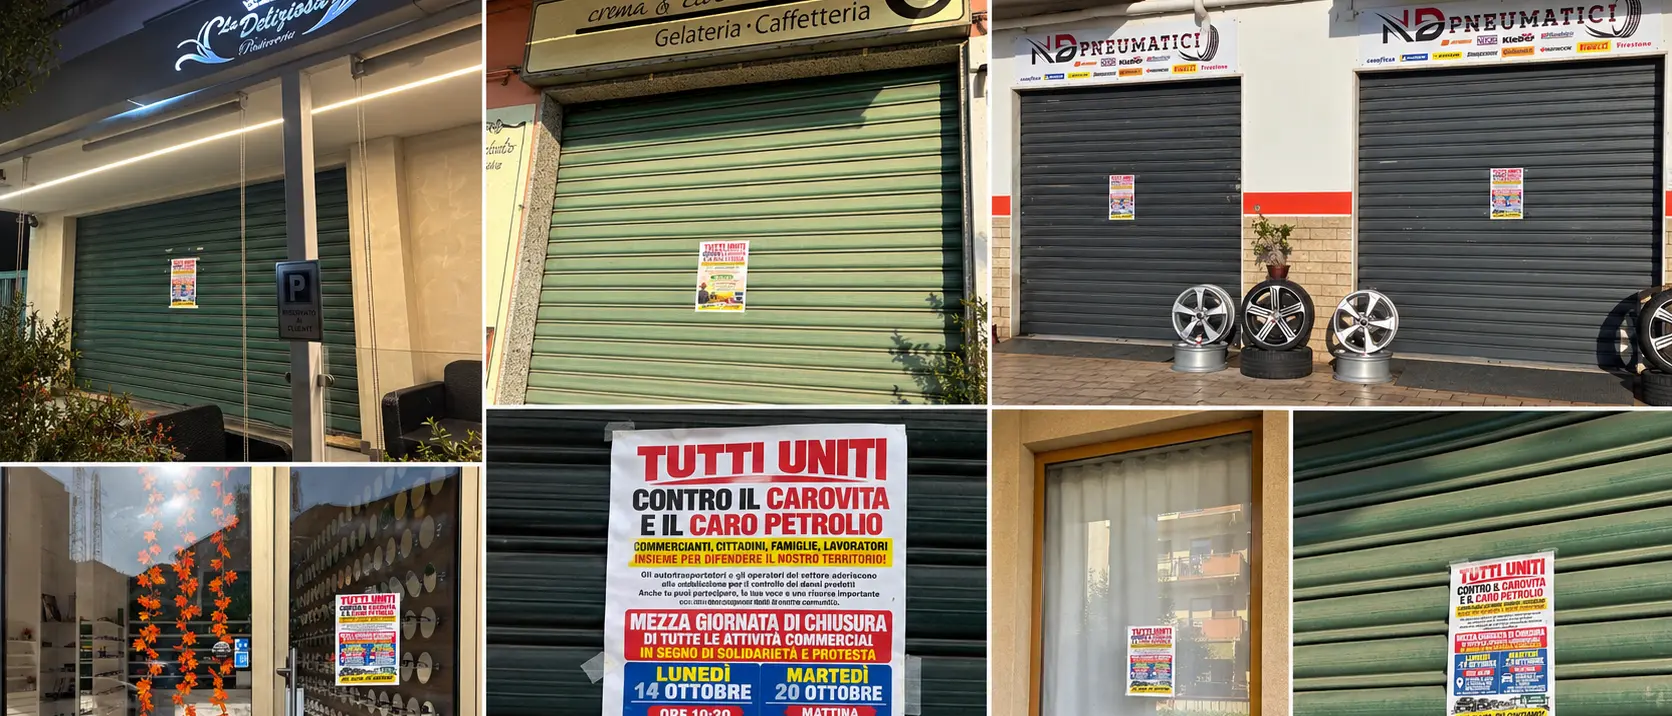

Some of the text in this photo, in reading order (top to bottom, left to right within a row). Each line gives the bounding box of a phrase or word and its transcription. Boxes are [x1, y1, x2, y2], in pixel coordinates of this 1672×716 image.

[588, 2, 648, 22] crema
[655, 0, 669, 15] &
[1449, 3, 1617, 33] PNEUMATICI
[655, 2, 870, 47] Gelateria Caffetteria
[1080, 32, 1200, 57] PNEUMATICI
[289, 275, 306, 301] P
[637, 438, 887, 481] TUTTI UNITI
[632, 487, 890, 511] CONTRO IL CAROVITA
[641, 513, 883, 536] E IL CARO PETROLIO
[634, 541, 888, 552] COMMERCIANTI, CITTADINI, FAMIGLIE, LAVORATORI
[634, 554, 887, 564] INSIEME PER DIFENDERE IL NOSTRO TERRITORIO!
[1459, 558, 1545, 584] TUTTI UNITI
[639, 589, 662, 597] Anche
[1457, 583, 1491, 595] CONTRO
[1501, 588, 1544, 600] PETROLIO
[340, 596, 369, 605] TUTTI
[630, 613, 888, 632] MEZZA GIORNATA DI CHIUSURA
[643, 632, 657, 645] DI
[660, 632, 701, 645] TUTTE
[704, 632, 720, 645] LE
[723, 631, 781, 646] ATTIVITÀ
[640, 647, 653, 658] IN
[656, 647, 698, 659] SEGNO
[702, 647, 714, 659] DI
[801, 648, 809, 660] E
[812, 648, 877, 661] PROTESTA
[656, 663, 730, 682] LUNEDÌ
[787, 665, 869, 684] MARTEDÌ
[634, 682, 752, 700] 14 OTTOBRE
[775, 683, 883, 701] 20 OTTOBRE
[802, 707, 859, 716] MATTINA
